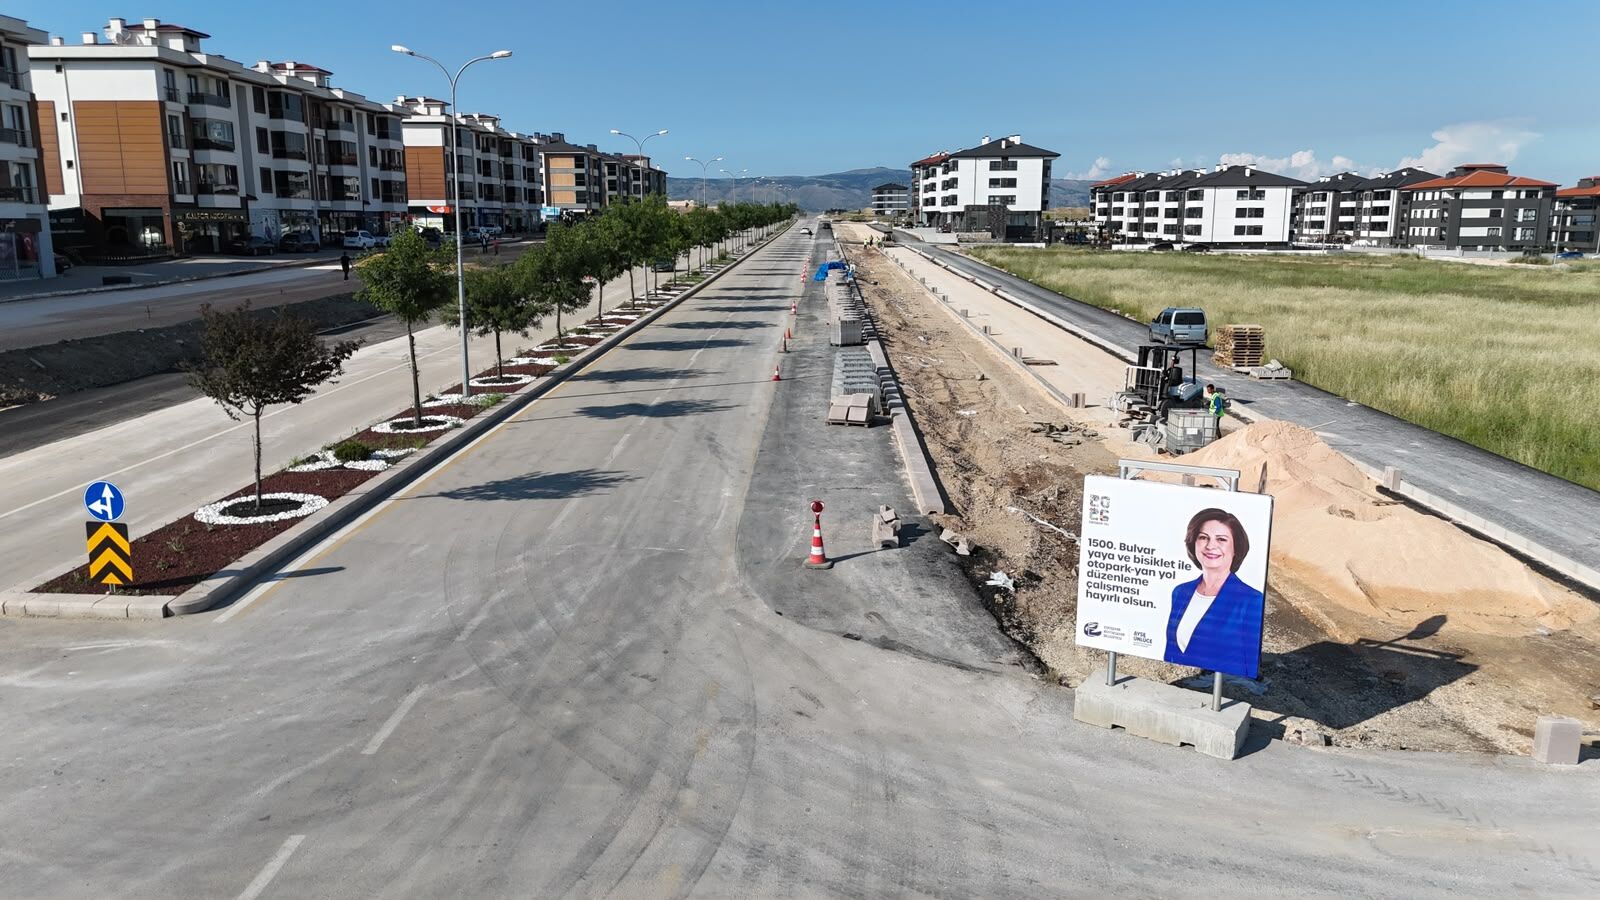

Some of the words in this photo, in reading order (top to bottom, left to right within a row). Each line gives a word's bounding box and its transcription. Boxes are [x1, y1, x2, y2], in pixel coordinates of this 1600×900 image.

[1088, 538, 1117, 550] 1500.
[1119, 542, 1156, 555] Bulvar
[1087, 549, 1115, 561] yaya
[1117, 553, 1131, 563] ve
[1133, 554, 1176, 569] bisiklet
[1178, 560, 1192, 571] ile
[1086, 569, 1149, 587] düzenleme
[1087, 560, 1156, 577] otopark-yan
[1158, 570, 1176, 580] yol
[1086, 580, 1140, 596] çalışması
[1085, 589, 1120, 603] hayırlı
[1122, 596, 1157, 609] olsun.
